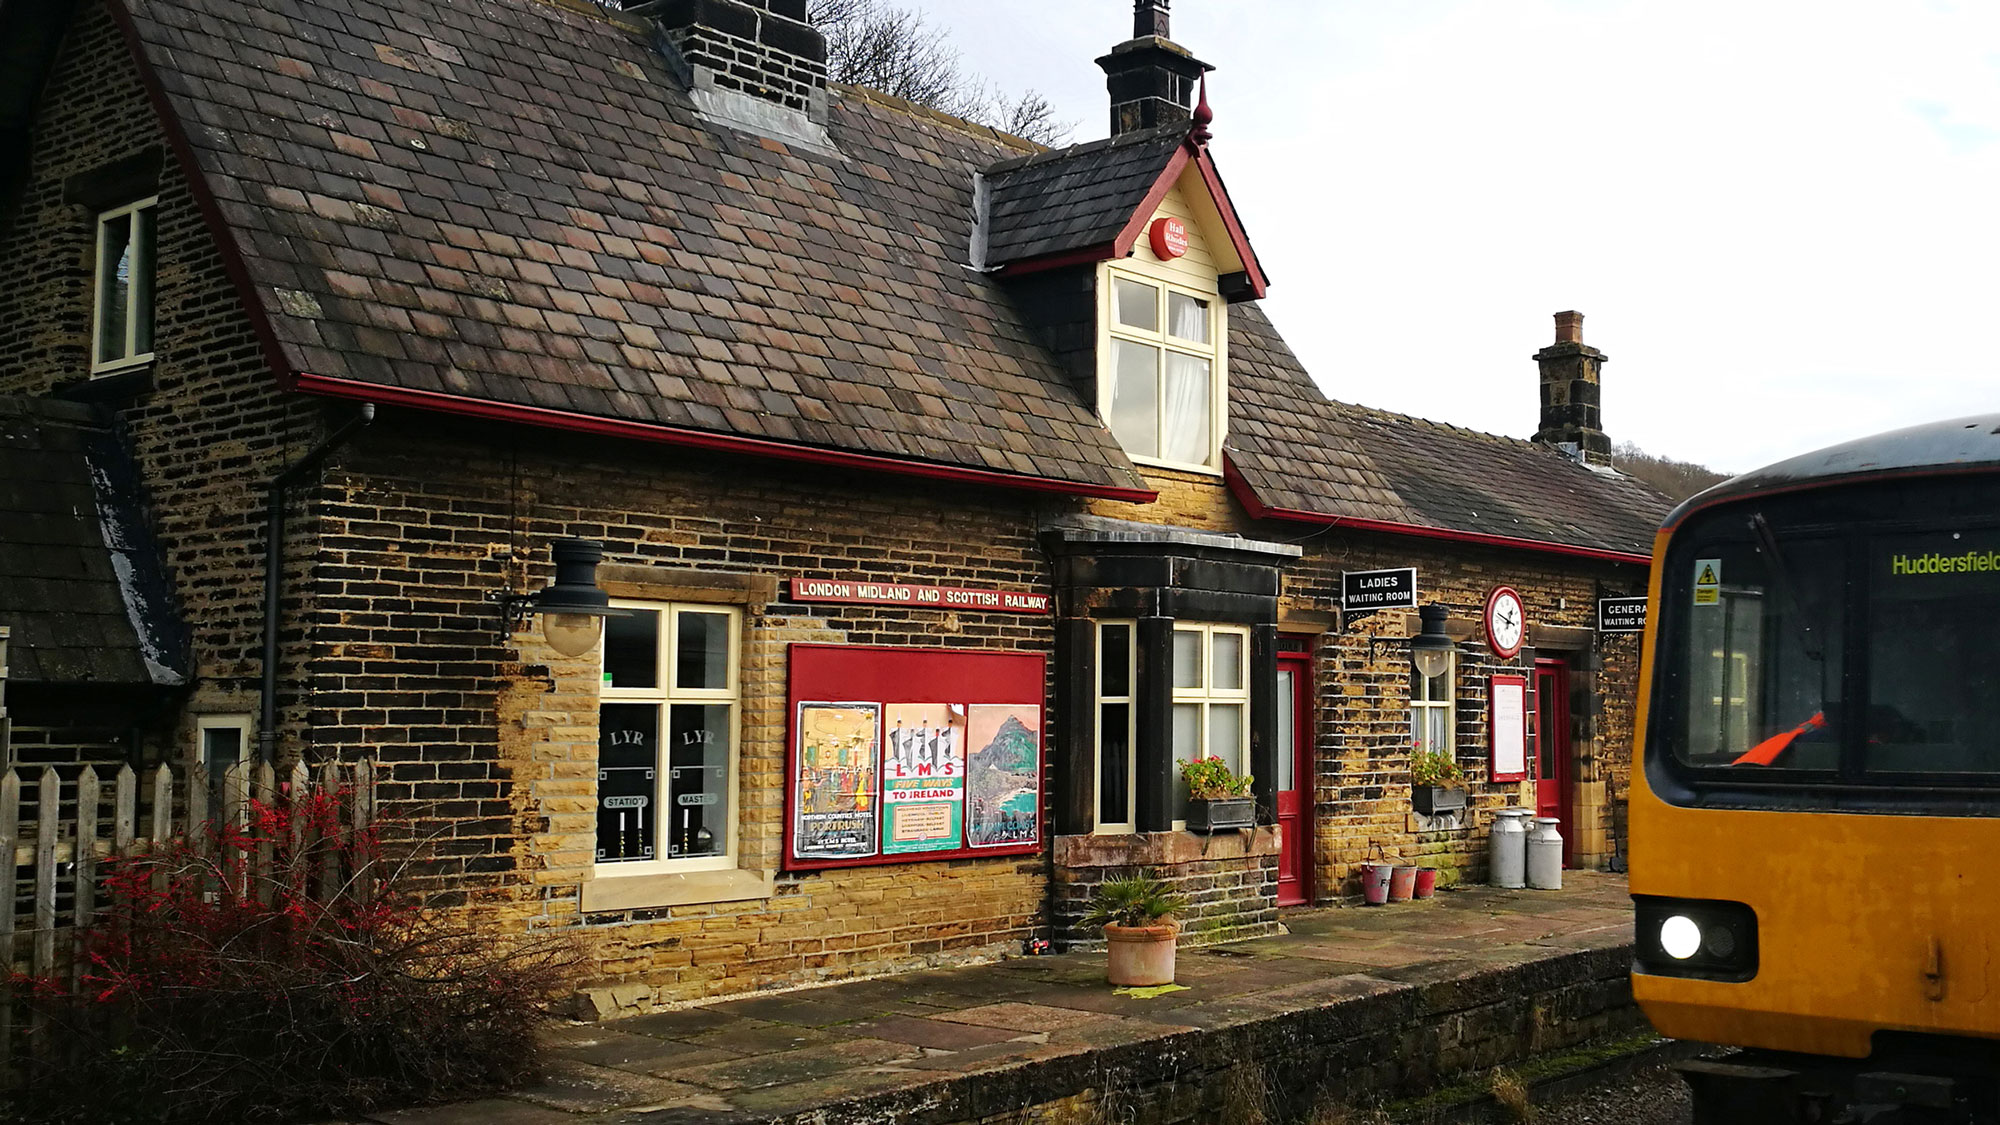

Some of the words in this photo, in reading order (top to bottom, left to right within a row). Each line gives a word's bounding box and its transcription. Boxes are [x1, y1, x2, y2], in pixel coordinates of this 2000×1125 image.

[1169, 221, 1184, 235] Hall
[1360, 576, 1398, 588] LADIES
[799, 582, 850, 597] LONDON
[857, 585, 911, 600] MIDLAND
[917, 588, 940, 602] AND
[946, 590, 999, 606] SCOTTISH
[1004, 594, 1047, 609] RAILWAY
[1348, 593, 1383, 603] WAITING
[1386, 591, 1411, 601] ROOM
[1608, 604, 1648, 614] GENERA
[1603, 617, 1635, 626] WAITING
[1637, 617, 1647, 625] RO
[610, 729, 644, 746] LYR
[682, 729, 715, 745] LYR
[893, 780, 919, 789] FIVE
[921, 778, 954, 788] WAYS
[682, 795, 709, 804] MAST
[892, 791, 907, 799] TO
[909, 789, 954, 798] IRELAND
[810, 819, 864, 831] PORTRUSH
